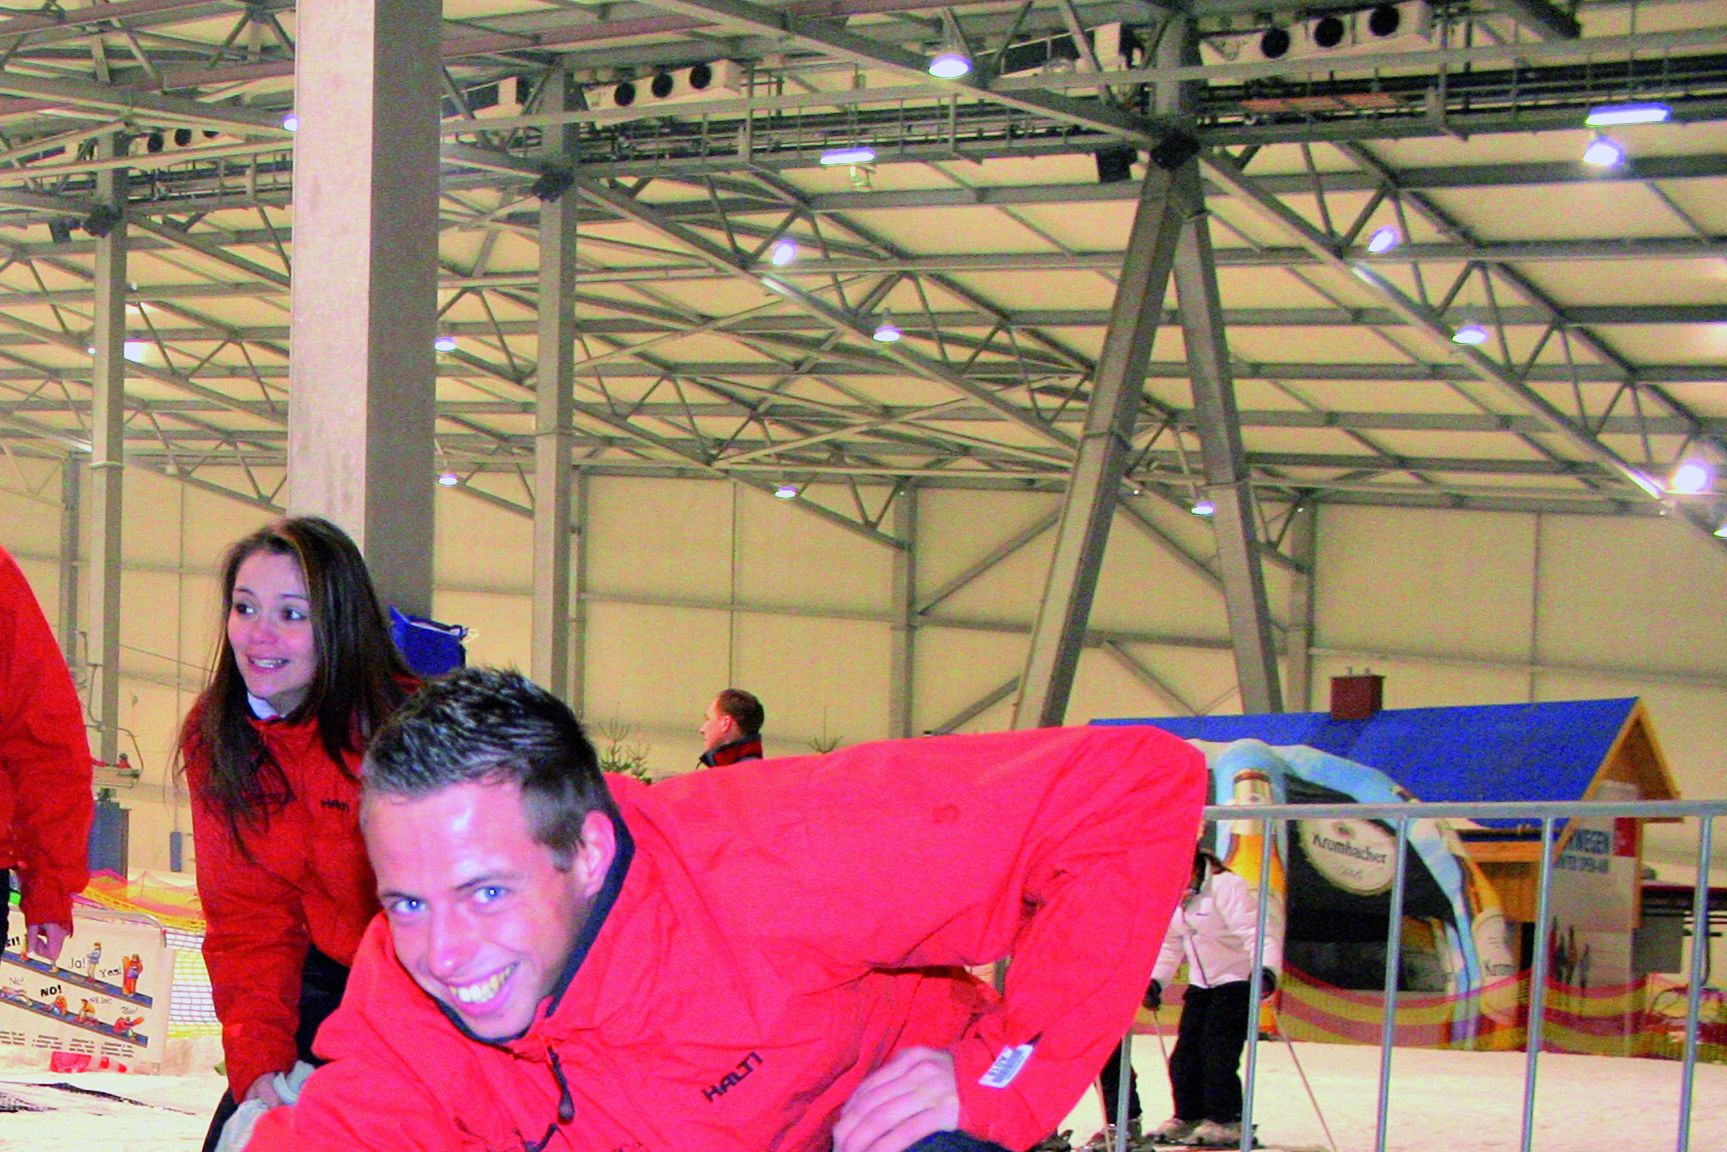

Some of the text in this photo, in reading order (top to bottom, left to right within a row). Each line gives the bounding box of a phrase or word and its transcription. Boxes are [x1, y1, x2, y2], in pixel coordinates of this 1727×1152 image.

[1313, 833, 1388, 864] Krombacher
[40, 984, 63, 997] NO!
[701, 1051, 764, 1103] HALTI
